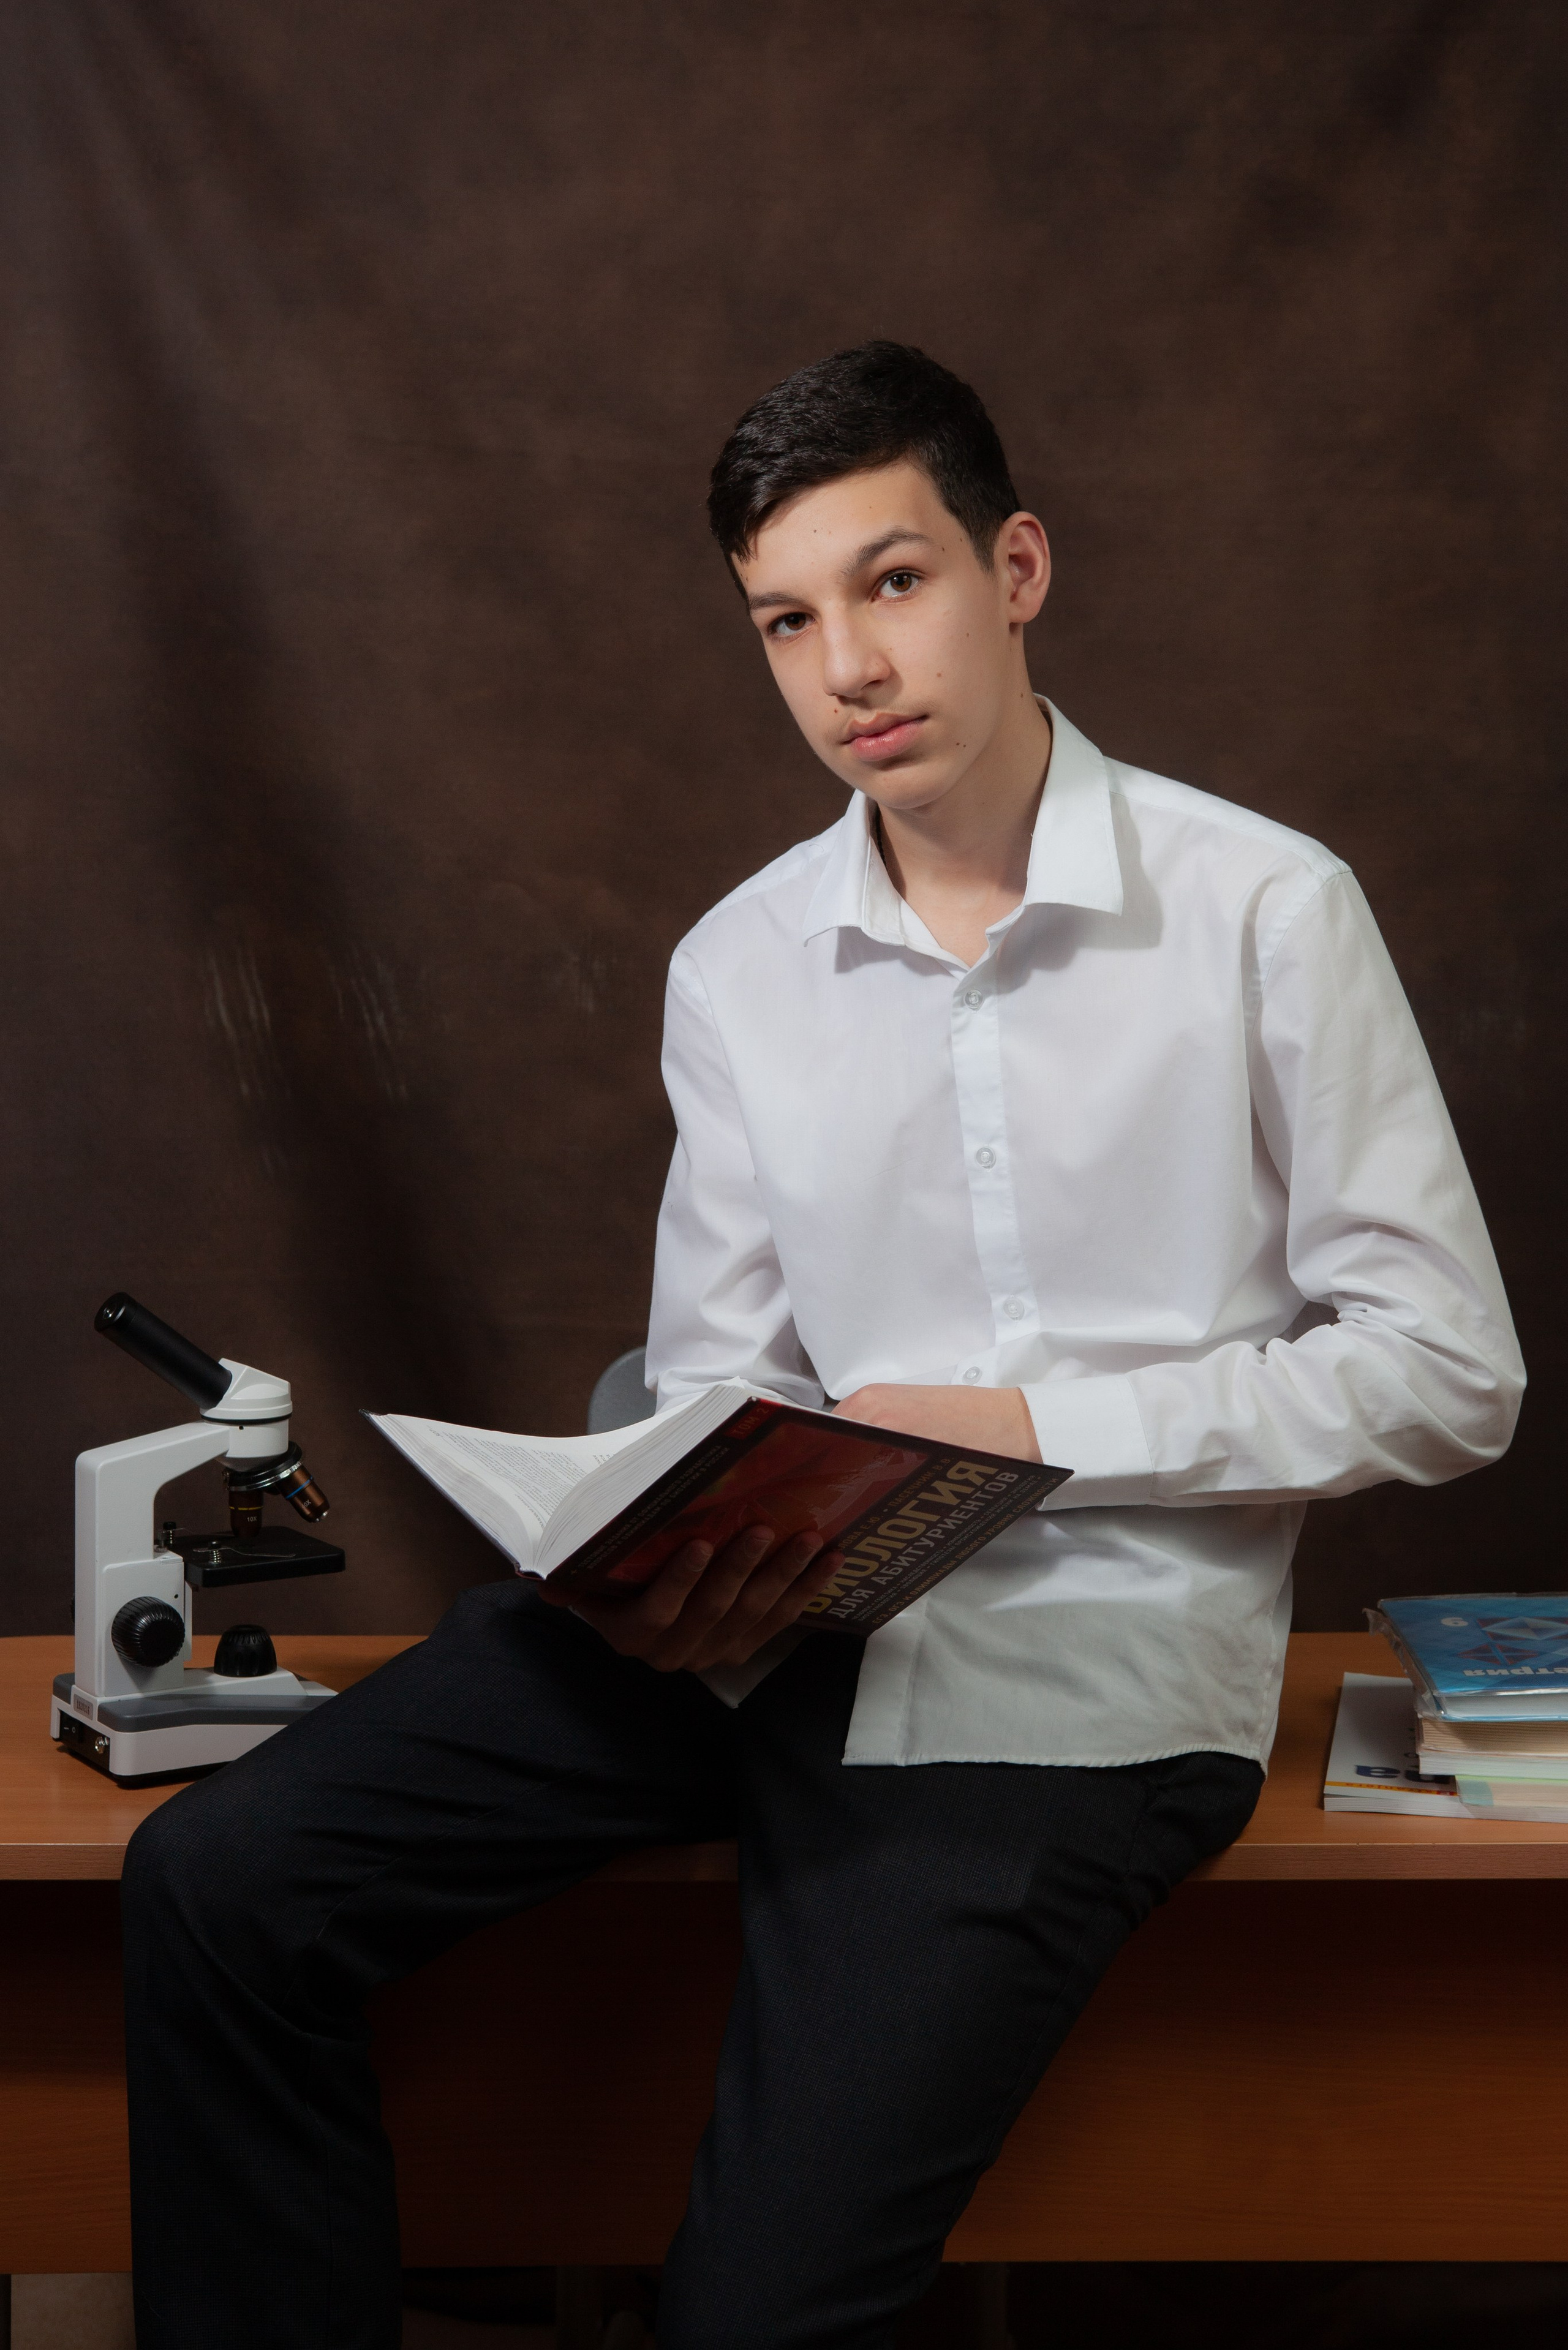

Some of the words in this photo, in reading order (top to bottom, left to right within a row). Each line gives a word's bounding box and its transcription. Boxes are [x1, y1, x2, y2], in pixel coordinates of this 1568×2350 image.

[731, 1416, 761, 1435] ТОМ
[886, 1470, 938, 1507] ПАСЕЧНИК
[930, 1455, 956, 1471] В.В.
[823, 1587, 877, 1619] ДЛЯ
[866, 1471, 1022, 1585] АБИТУРИЕНТОВ
[886, 1600, 906, 1611] ОГЭ
[908, 1559, 959, 1595] ОЛИМПИАДЫ
[953, 1535, 988, 1559] ЛЮБОГО
[982, 1513, 1016, 1536] УРОВНЯ
[1011, 1477, 1061, 1513] СЛОЖНОСТИ
